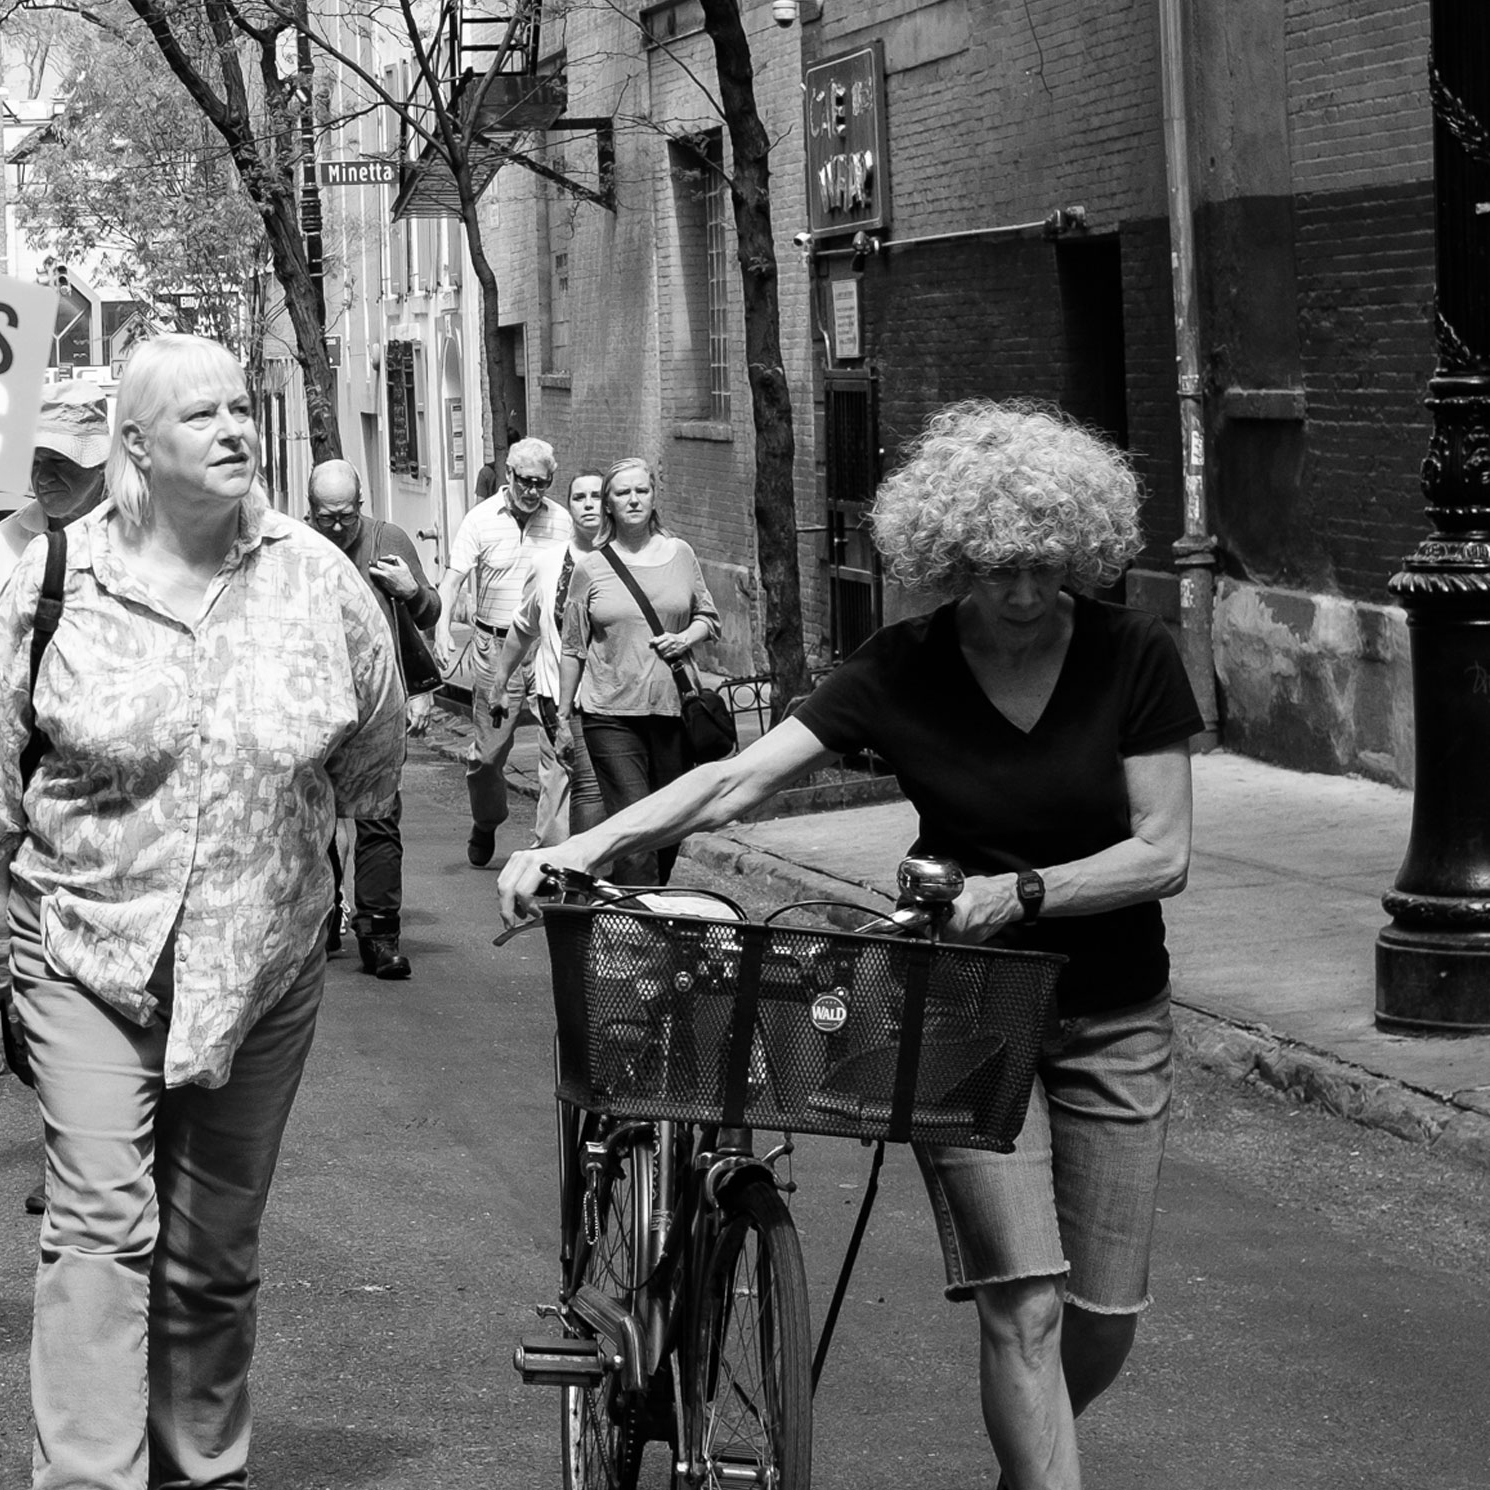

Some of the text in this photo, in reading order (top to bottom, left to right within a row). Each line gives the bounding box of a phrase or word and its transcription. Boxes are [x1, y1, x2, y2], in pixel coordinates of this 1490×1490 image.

[328, 163, 392, 182] Minetta
[180, 297, 200, 310] Billy
[812, 1006, 847, 1021] WALD
